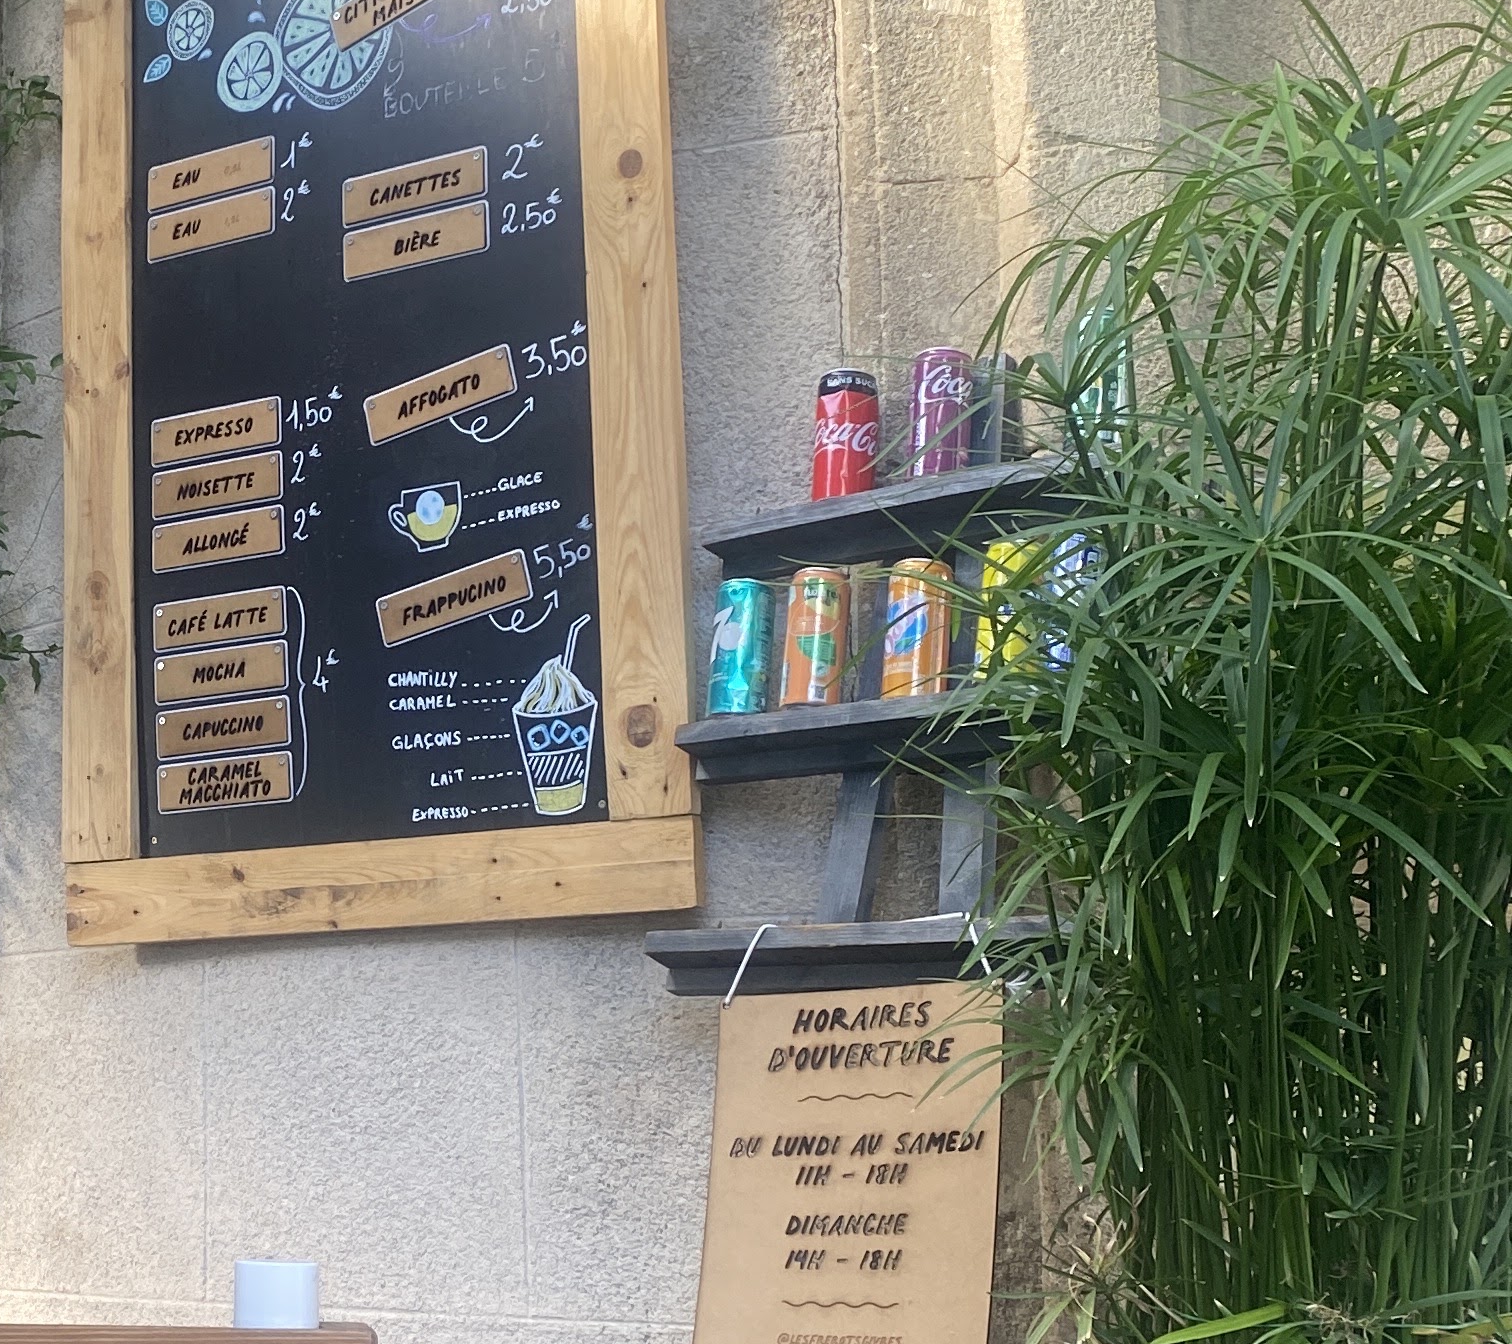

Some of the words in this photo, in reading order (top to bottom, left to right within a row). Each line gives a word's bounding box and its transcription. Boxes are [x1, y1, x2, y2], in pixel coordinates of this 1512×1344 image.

[172, 168, 201, 190] EAU
[370, 168, 461, 206] CANETTES
[172, 219, 201, 240] EAU
[394, 230, 441, 256] BIÈRE
[397, 373, 481, 420] AFFOGATO
[174, 417, 253, 446] EXPRESSO
[177, 472, 255, 501] NOISETTE
[497, 471, 543, 491] GLACE
[498, 500, 561, 521] EXPRESSO
[182, 523, 249, 556] ALLONGÉ
[402, 575, 507, 626] FRAPPUCINO
[168, 610, 207, 637] CAFÉ
[213, 606, 268, 628] LATTE
[193, 661, 246, 684] MOCHA
[388, 669, 458, 688] CHANTILLY
[389, 694, 457, 711] CARAMEL
[183, 715, 264, 741] CAPUCCINO
[392, 731, 462, 750] GLAÇONS
[188, 760, 262, 785] CARAMEL
[430, 769, 464, 787] LAIT
[179, 779, 271, 805] MACCHIATO
[412, 807, 469, 822] EXPRESSO
[792, 1000, 932, 1035] HORAIRES
[768, 1037, 954, 1073] D'OUVERTURE
[730, 1137, 762, 1158] DU
[772, 1135, 840, 1157] LUNDI
[850, 1133, 883, 1156] AU
[895, 1130, 985, 1155] SAMEDI
[795, 1165, 831, 1186] 11H
[866, 1163, 909, 1185] 18H
[785, 1213, 909, 1235] DIMANCHE
[860, 1249, 902, 1270] 18H
